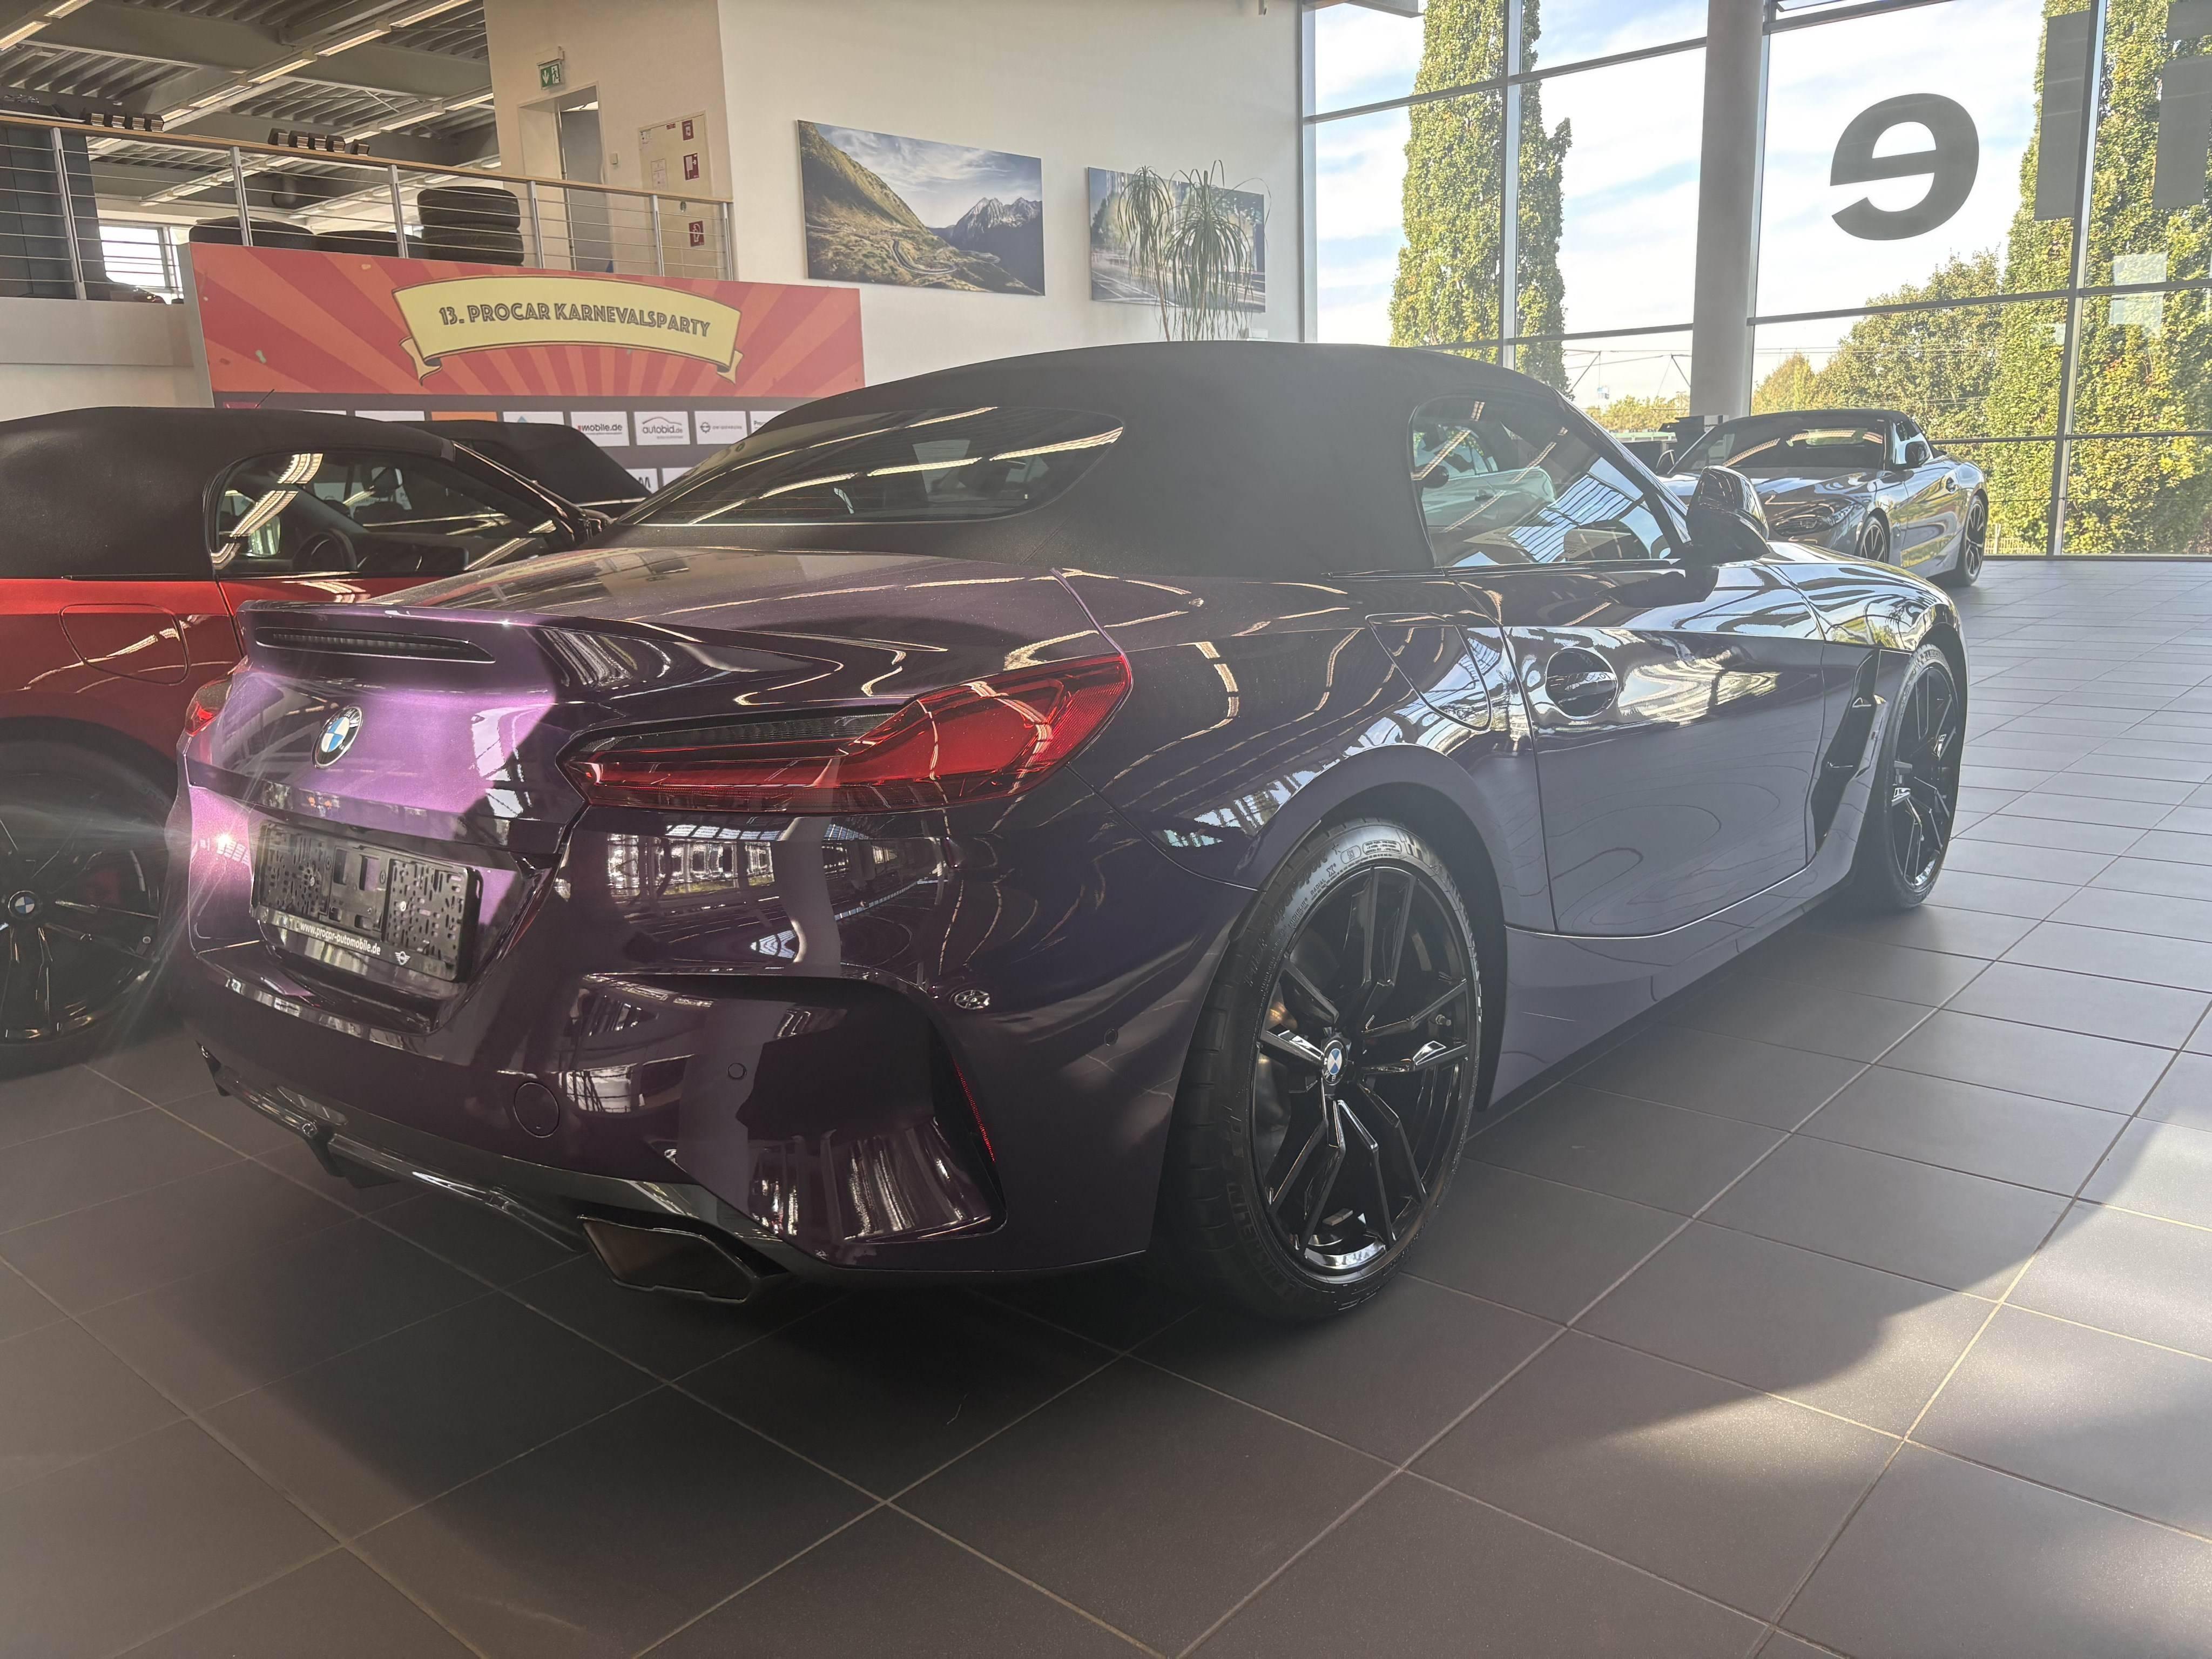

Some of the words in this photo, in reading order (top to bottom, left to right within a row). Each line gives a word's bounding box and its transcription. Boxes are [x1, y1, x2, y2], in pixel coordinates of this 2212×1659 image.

[439, 307, 464, 325] 13.
[468, 302, 551, 323] PROCAR
[554, 303, 711, 338] KARNEVALSPARTY
[582, 423, 623, 431] mobile.de
[642, 425, 683, 434] autobid.de
[1310, 878, 1326, 895] RADIAL
[300, 921, 381, 956] www.procar-automobile.de
